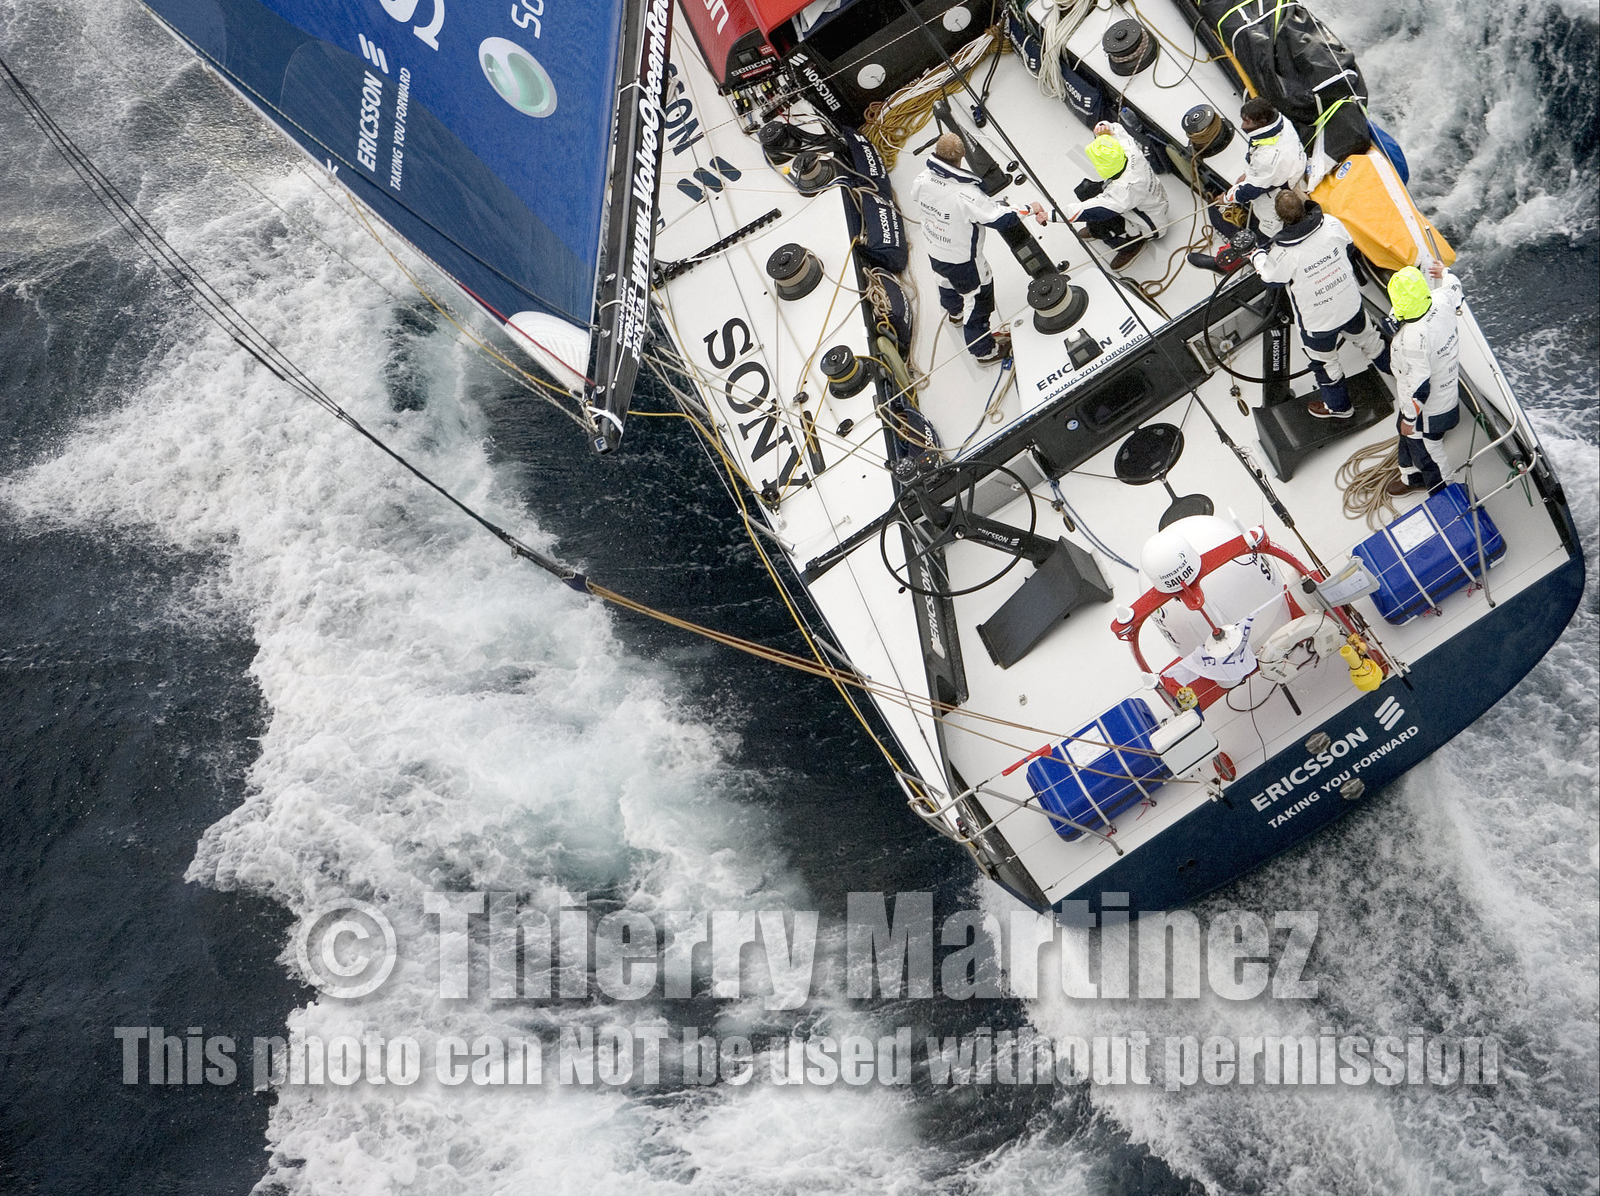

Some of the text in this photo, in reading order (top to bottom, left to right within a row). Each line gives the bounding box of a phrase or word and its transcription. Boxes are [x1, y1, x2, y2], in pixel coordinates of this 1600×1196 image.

[731, 55, 776, 77] semcon
[803, 66, 841, 112] ERICSSON
[357, 70, 383, 172] ERICSSON
[390, 67, 411, 191] TAKING YOU FORWARD
[862, 144, 879, 177] ERICSSON
[878, 207, 891, 244] ERICSSON
[1303, 254, 1332, 274] ERICSSON
[625, 286, 636, 349] VOLVO
[632, 296, 645, 364] PENTA
[1036, 336, 1113, 391] ERICN
[1044, 334, 1144, 401] TAKING YOU FORWARD
[1272, 339, 1280, 371] ERICSSON
[703, 316, 813, 500] SONY
[1159, 559, 1188, 580] inmarsat
[1164, 565, 1194, 589] SAILOR
[1250, 726, 1369, 812] ERICSSON
[1267, 725, 1419, 829] TAKING YOU FORWARD
